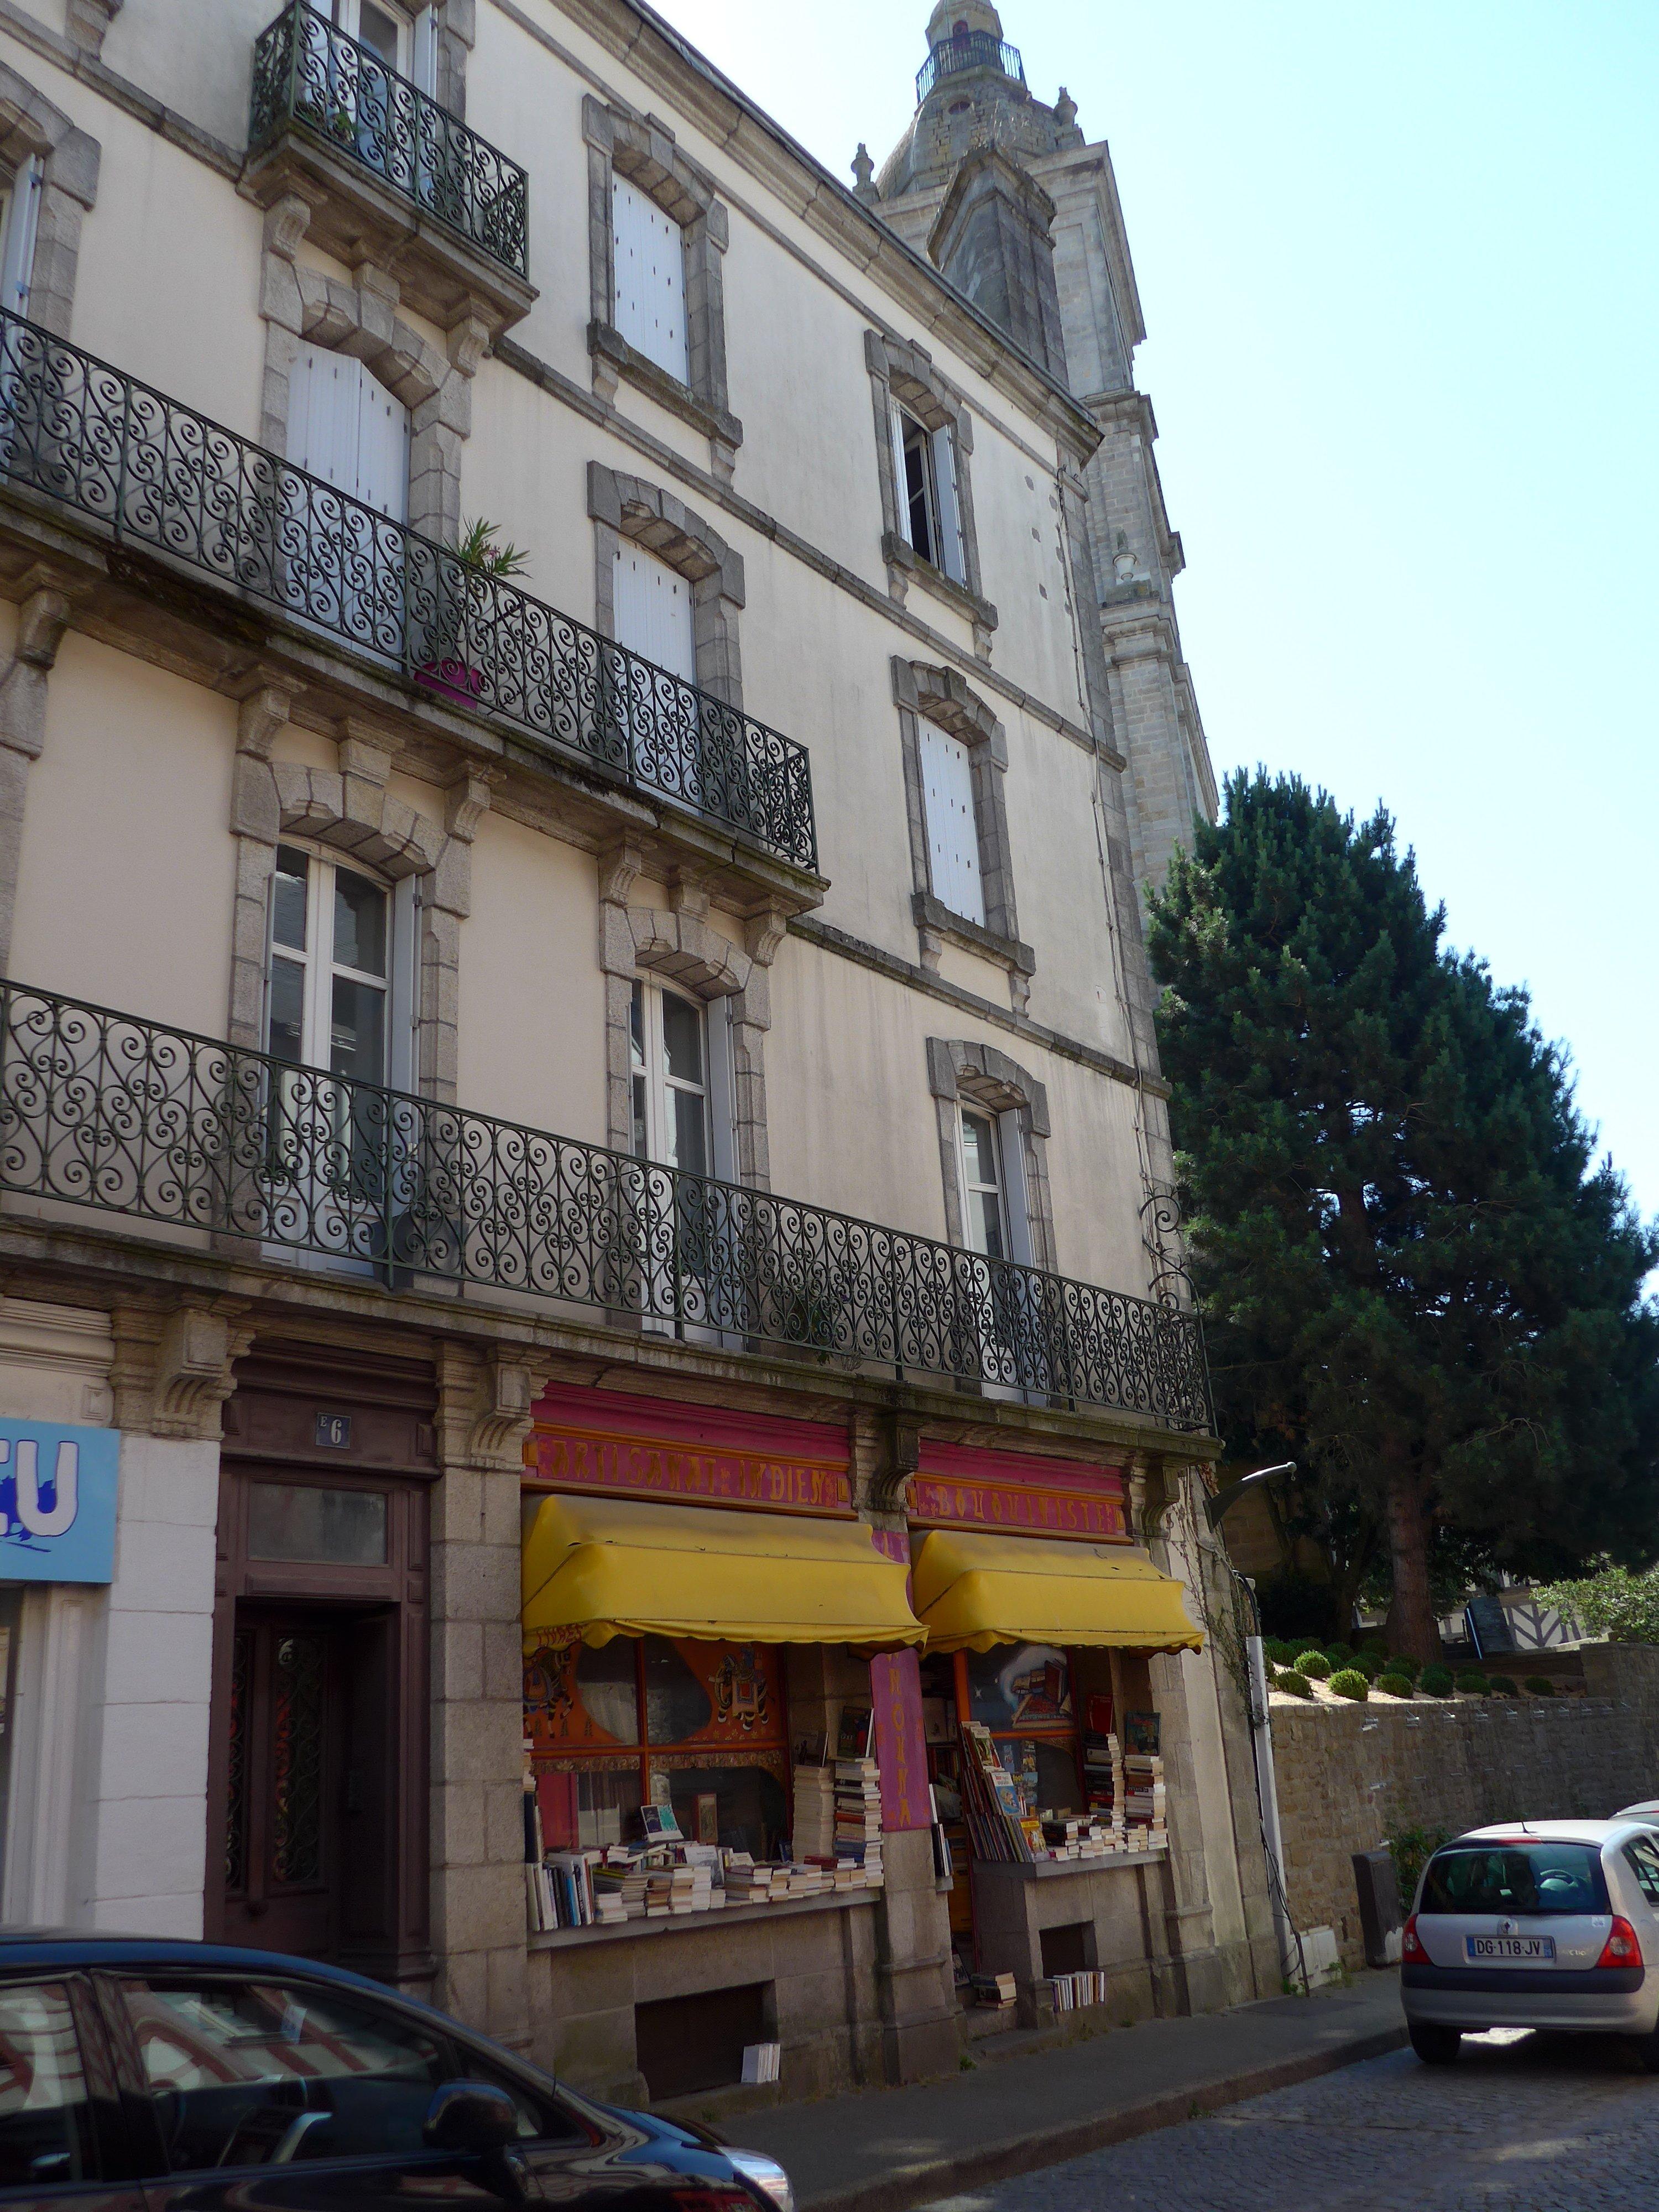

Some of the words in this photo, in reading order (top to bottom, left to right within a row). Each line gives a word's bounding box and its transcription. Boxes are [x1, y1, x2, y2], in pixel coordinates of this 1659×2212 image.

[331, 1418, 342, 1444] 6
[0, 1438, 80, 1537] U
[551, 1439, 717, 1494] ARTISANAT
[740, 1459, 826, 1505] INDIEN
[937, 1485, 1105, 1532] BOUQUINISTE
[1477, 1939, 1540, 1955] DG-118-JV
